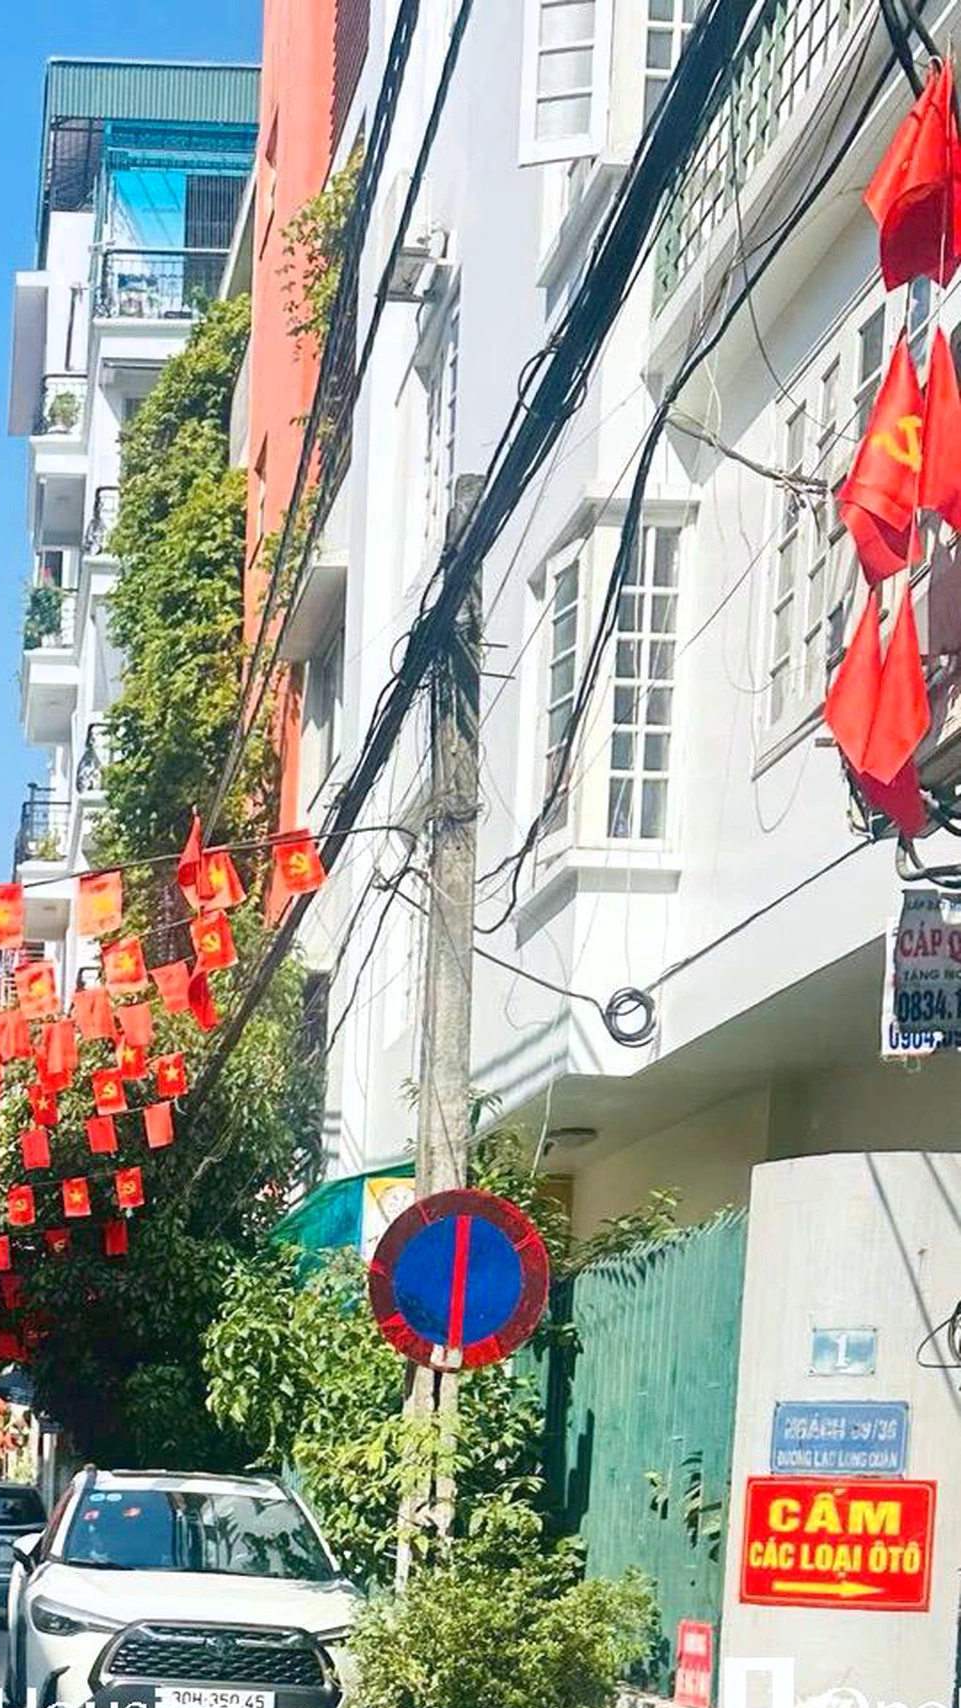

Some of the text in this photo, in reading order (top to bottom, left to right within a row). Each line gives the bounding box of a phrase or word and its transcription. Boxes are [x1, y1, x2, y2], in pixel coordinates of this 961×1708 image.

[833, 1332, 849, 1368] 1
[768, 1487, 903, 1535] CẤM
[749, 1537, 921, 1578] CÁC LOẠI ÔTÔ
